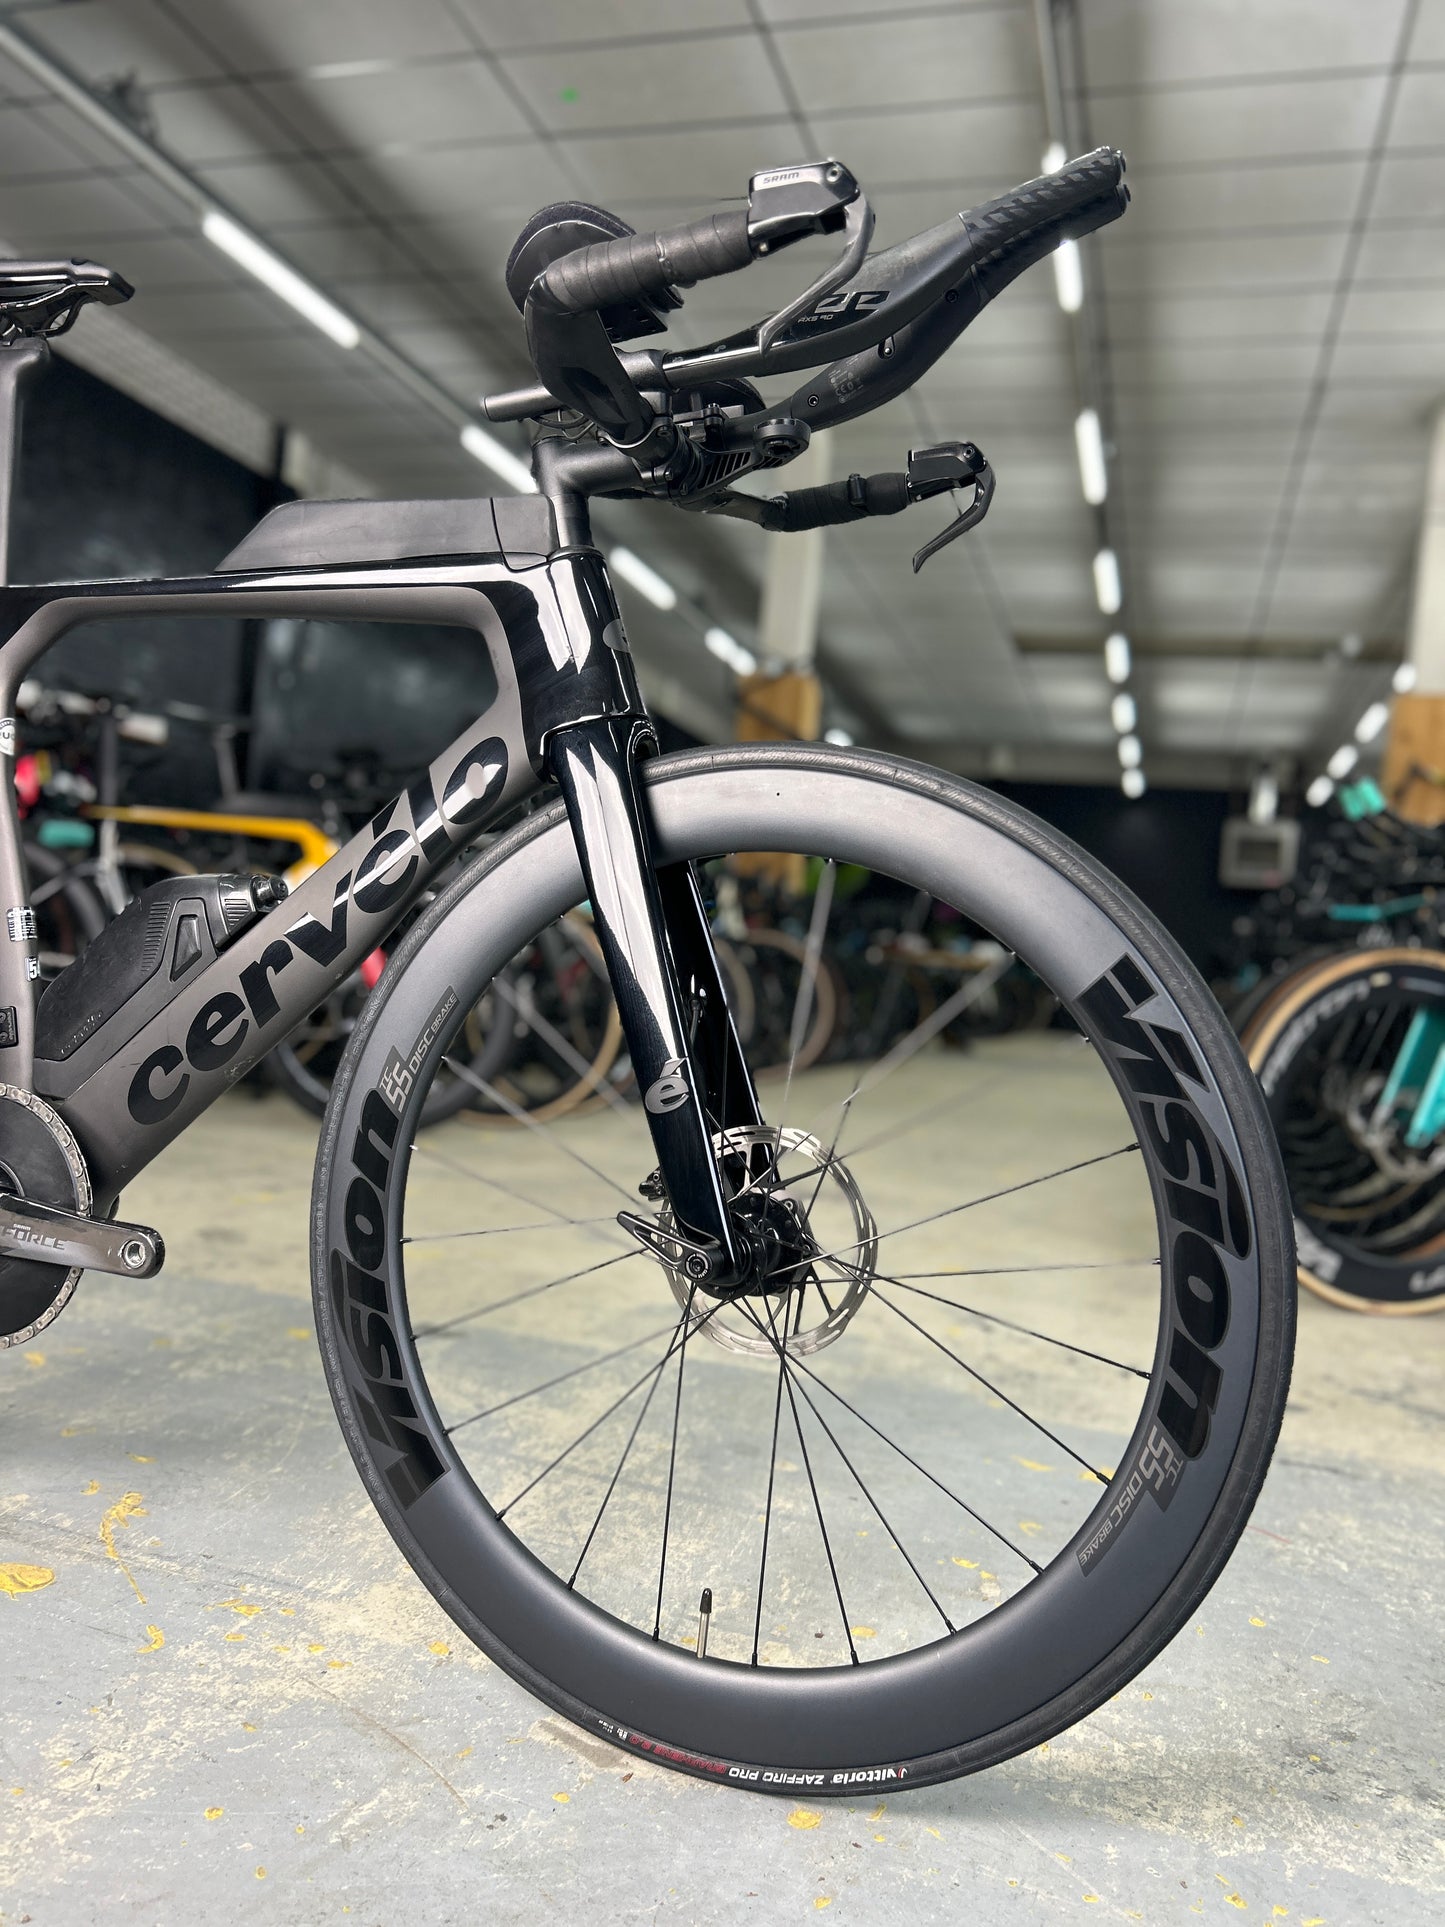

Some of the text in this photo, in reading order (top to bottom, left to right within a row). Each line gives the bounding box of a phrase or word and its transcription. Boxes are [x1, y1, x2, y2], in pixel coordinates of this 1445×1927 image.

[763, 171, 799, 184] SRAM
[385, 993, 458, 1113] 55 DISC BRAKE
[379, 1066, 393, 1090] TC
[1165, 1459, 1184, 1487] TC
[1079, 1425, 1175, 1566] 55 DISC BRAKE
[729, 1767, 758, 1782] PRO
[762, 1770, 825, 1785] ZAFFIRO
